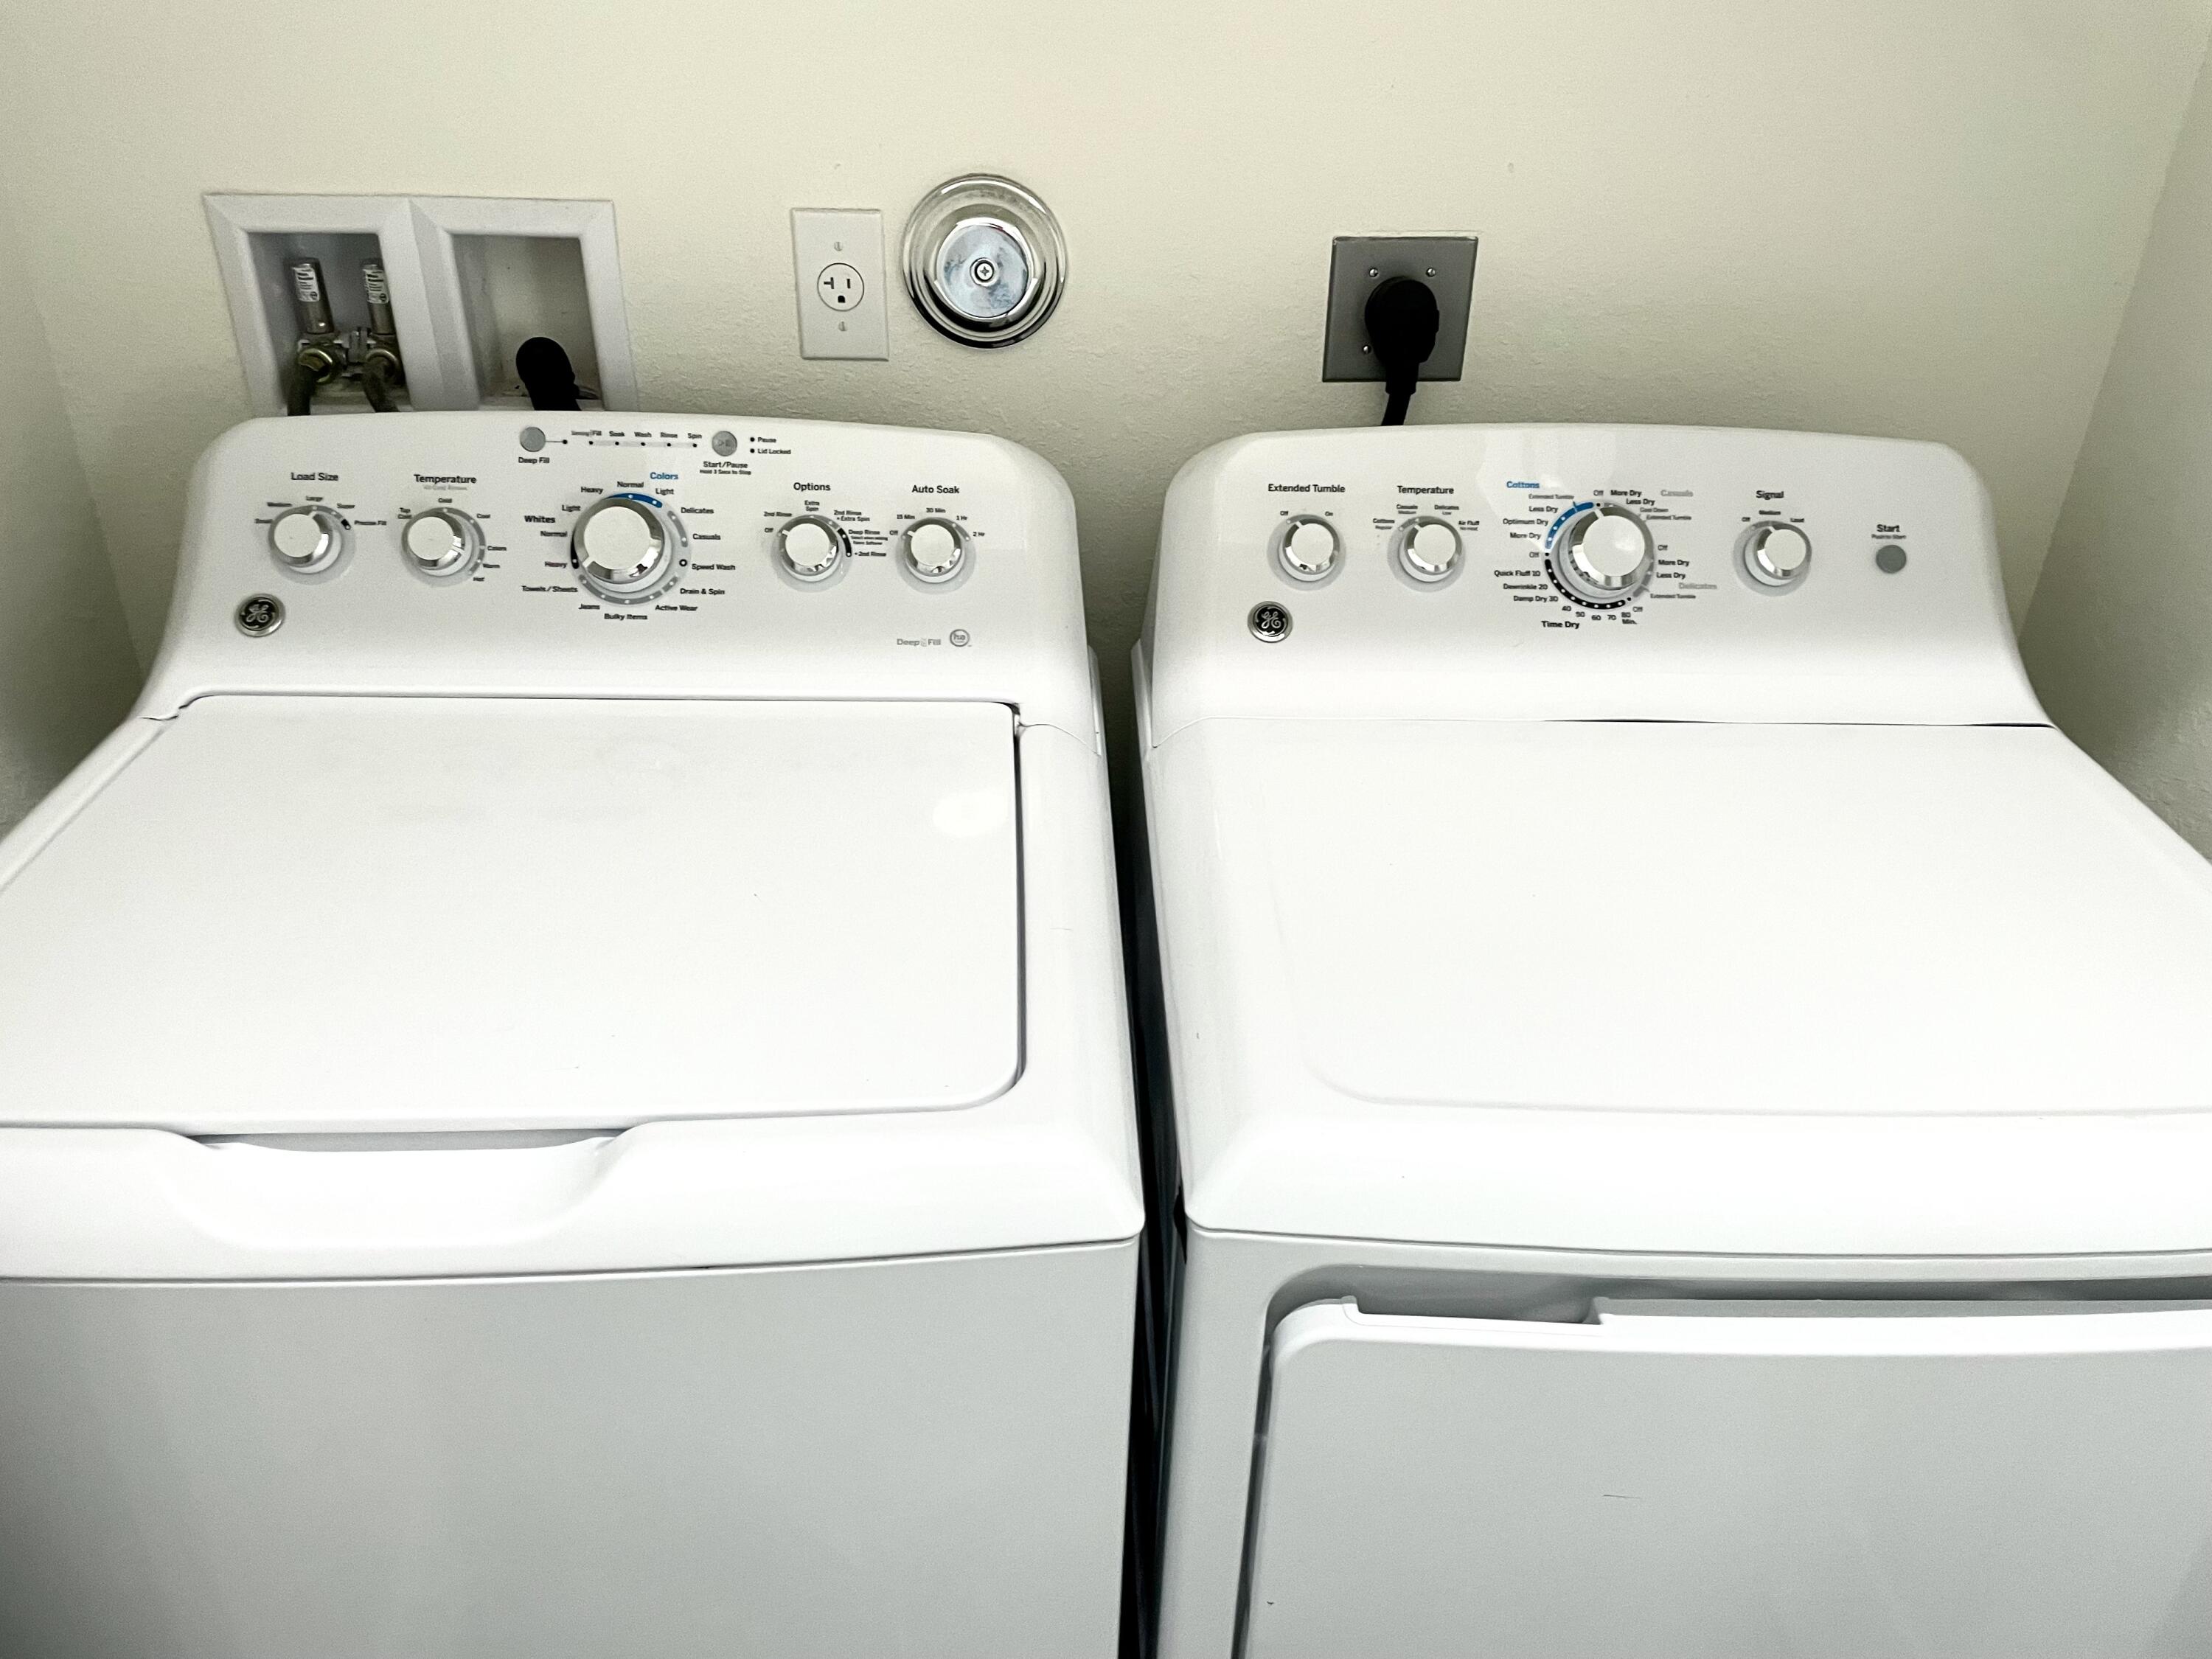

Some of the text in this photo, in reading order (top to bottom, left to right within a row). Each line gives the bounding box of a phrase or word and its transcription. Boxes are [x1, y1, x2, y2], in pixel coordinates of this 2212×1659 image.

[518, 456, 537, 465] Deep
[291, 473, 338, 481] Load Size
[414, 475, 476, 484] Temperature
[793, 482, 830, 492] Options
[912, 485, 959, 494] Auto Soak
[1268, 484, 1345, 493] Extended Tumble
[1506, 481, 1540, 489] Cottons
[581, 487, 603, 495] Heavy
[655, 487, 674, 495] Light
[1397, 486, 1454, 495] Temperature
[1756, 490, 1784, 500] Signal
[1877, 524, 1900, 532] Start
[692, 563, 714, 571] Speed
